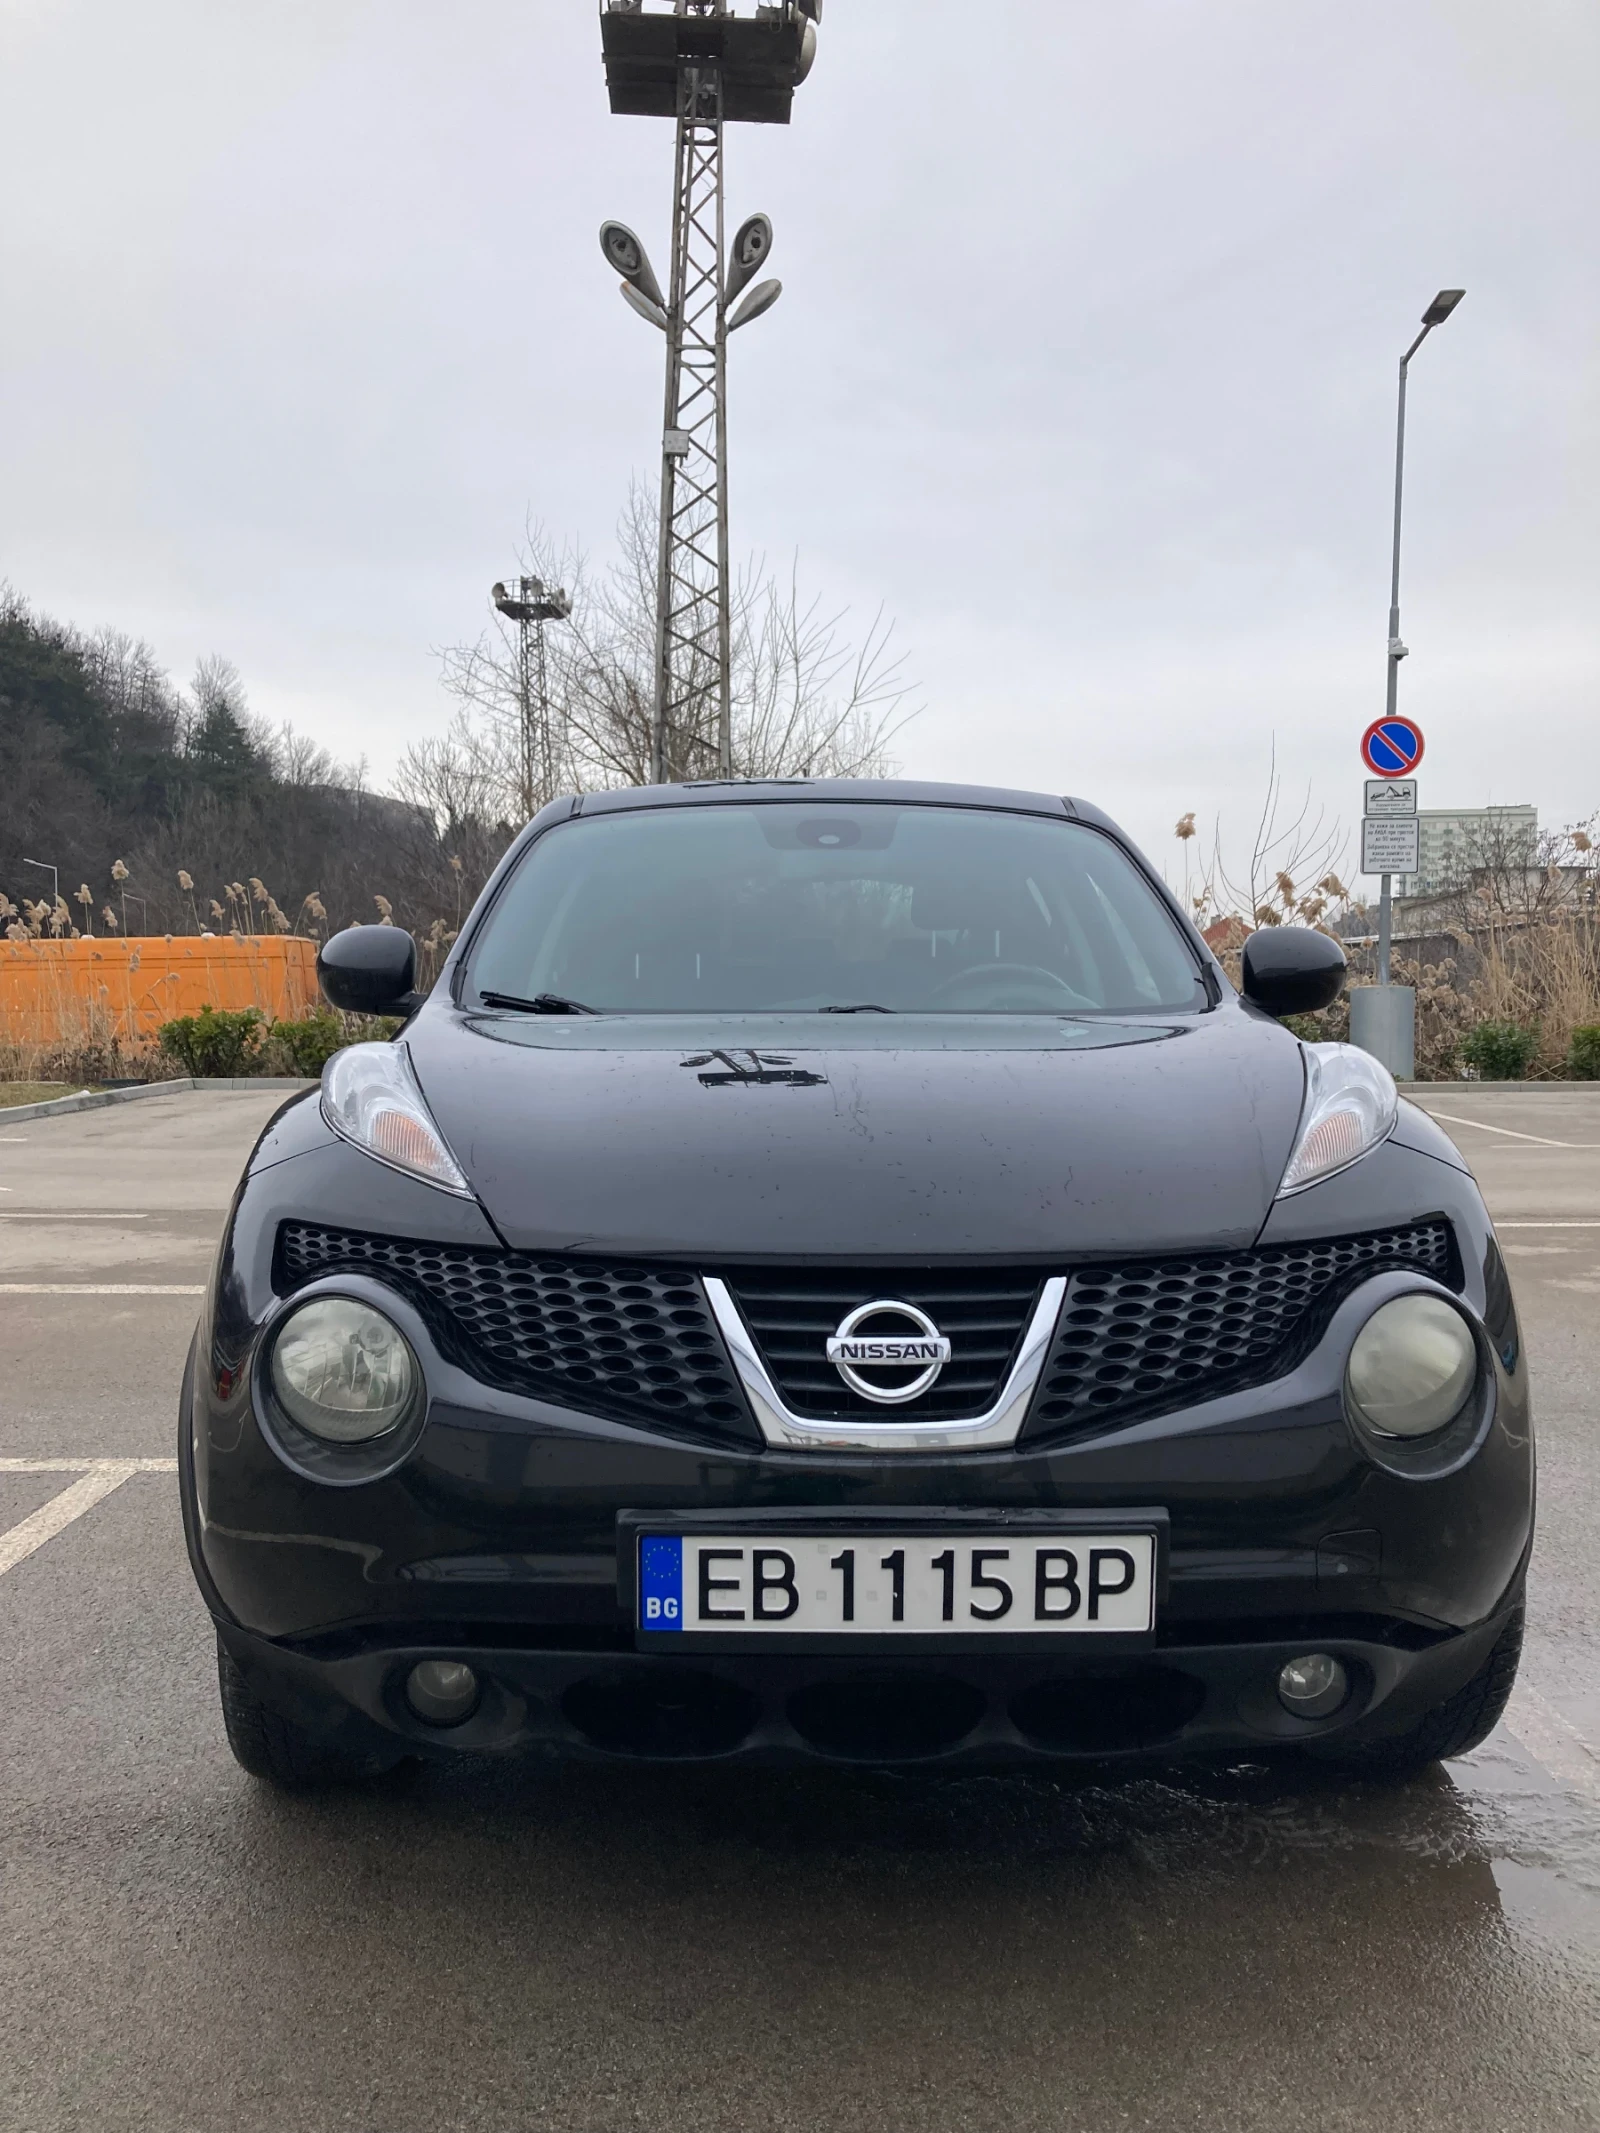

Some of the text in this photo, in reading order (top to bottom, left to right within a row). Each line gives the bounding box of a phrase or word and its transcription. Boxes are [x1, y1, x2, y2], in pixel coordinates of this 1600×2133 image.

[840, 1343, 938, 1359] NISSAN
[698, 1549, 1136, 1621] EB 1115 BP
[647, 1597, 678, 1618] BG
